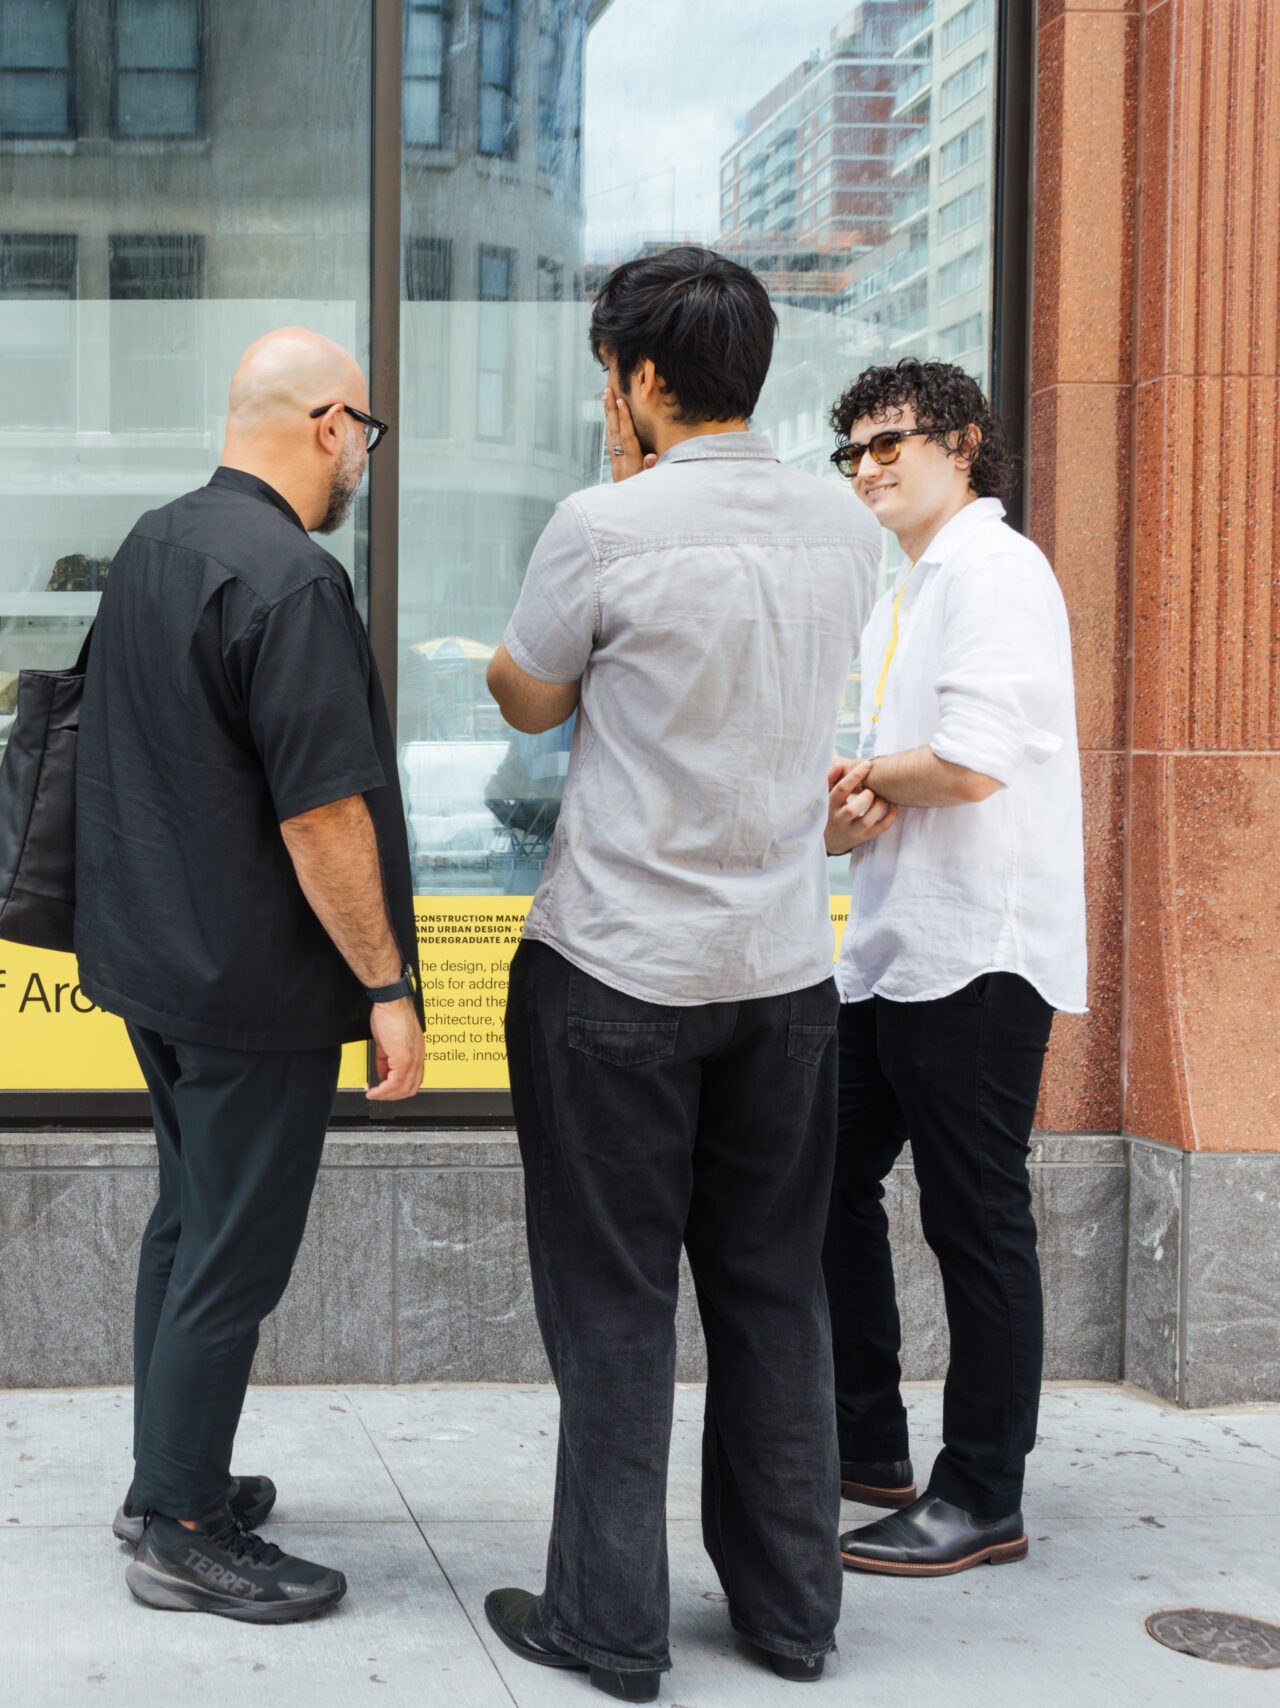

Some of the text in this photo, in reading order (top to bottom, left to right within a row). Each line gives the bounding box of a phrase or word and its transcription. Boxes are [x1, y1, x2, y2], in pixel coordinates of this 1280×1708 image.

[414, 914, 493, 922] CONSTRUCTION
[496, 914, 525, 922] MANA
[437, 925, 472, 933] URBAN
[474, 925, 512, 933] DESIGN
[440, 960, 486, 974] design,
[448, 977, 465, 990] for
[19, 972, 106, 1013] Arc
[458, 996, 482, 1008] and
[486, 996, 506, 1008] the
[469, 1032, 483, 1043] to
[485, 1031, 505, 1043] the
[183, 1547, 265, 1600] TERREX
